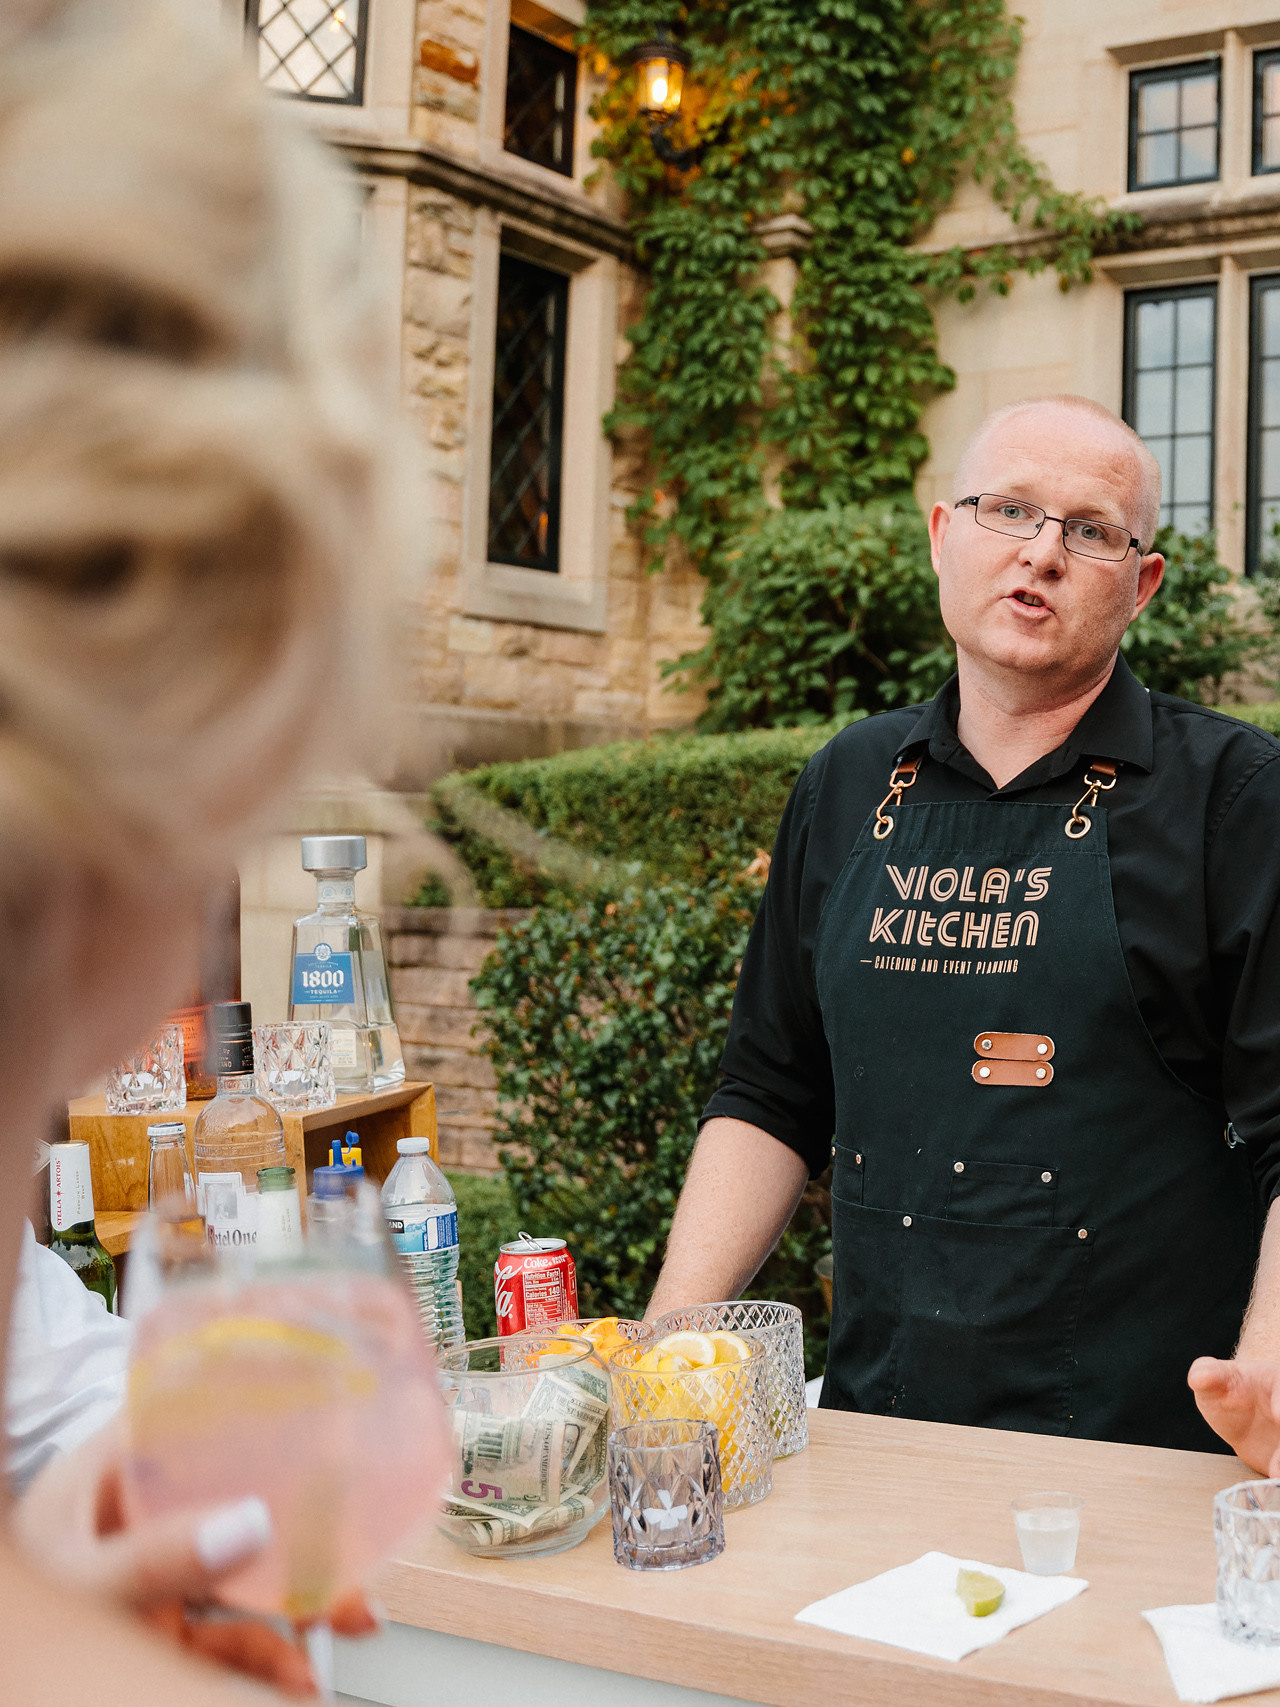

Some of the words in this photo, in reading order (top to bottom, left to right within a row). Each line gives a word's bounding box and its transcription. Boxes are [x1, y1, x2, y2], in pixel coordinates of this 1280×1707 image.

[886, 864, 1052, 903] VIOLA'S
[874, 956, 917, 972] CATERING
[921, 959, 938, 973] AND
[943, 959, 972, 975] EVENT
[976, 959, 1019, 975] PLANNING
[302, 970, 344, 988] 1800
[232, 1229, 257, 1246] One
[524, 1257, 549, 1269] Coke
[548, 1286, 560, 1295] 140
[461, 1479, 503, 1500] 5
